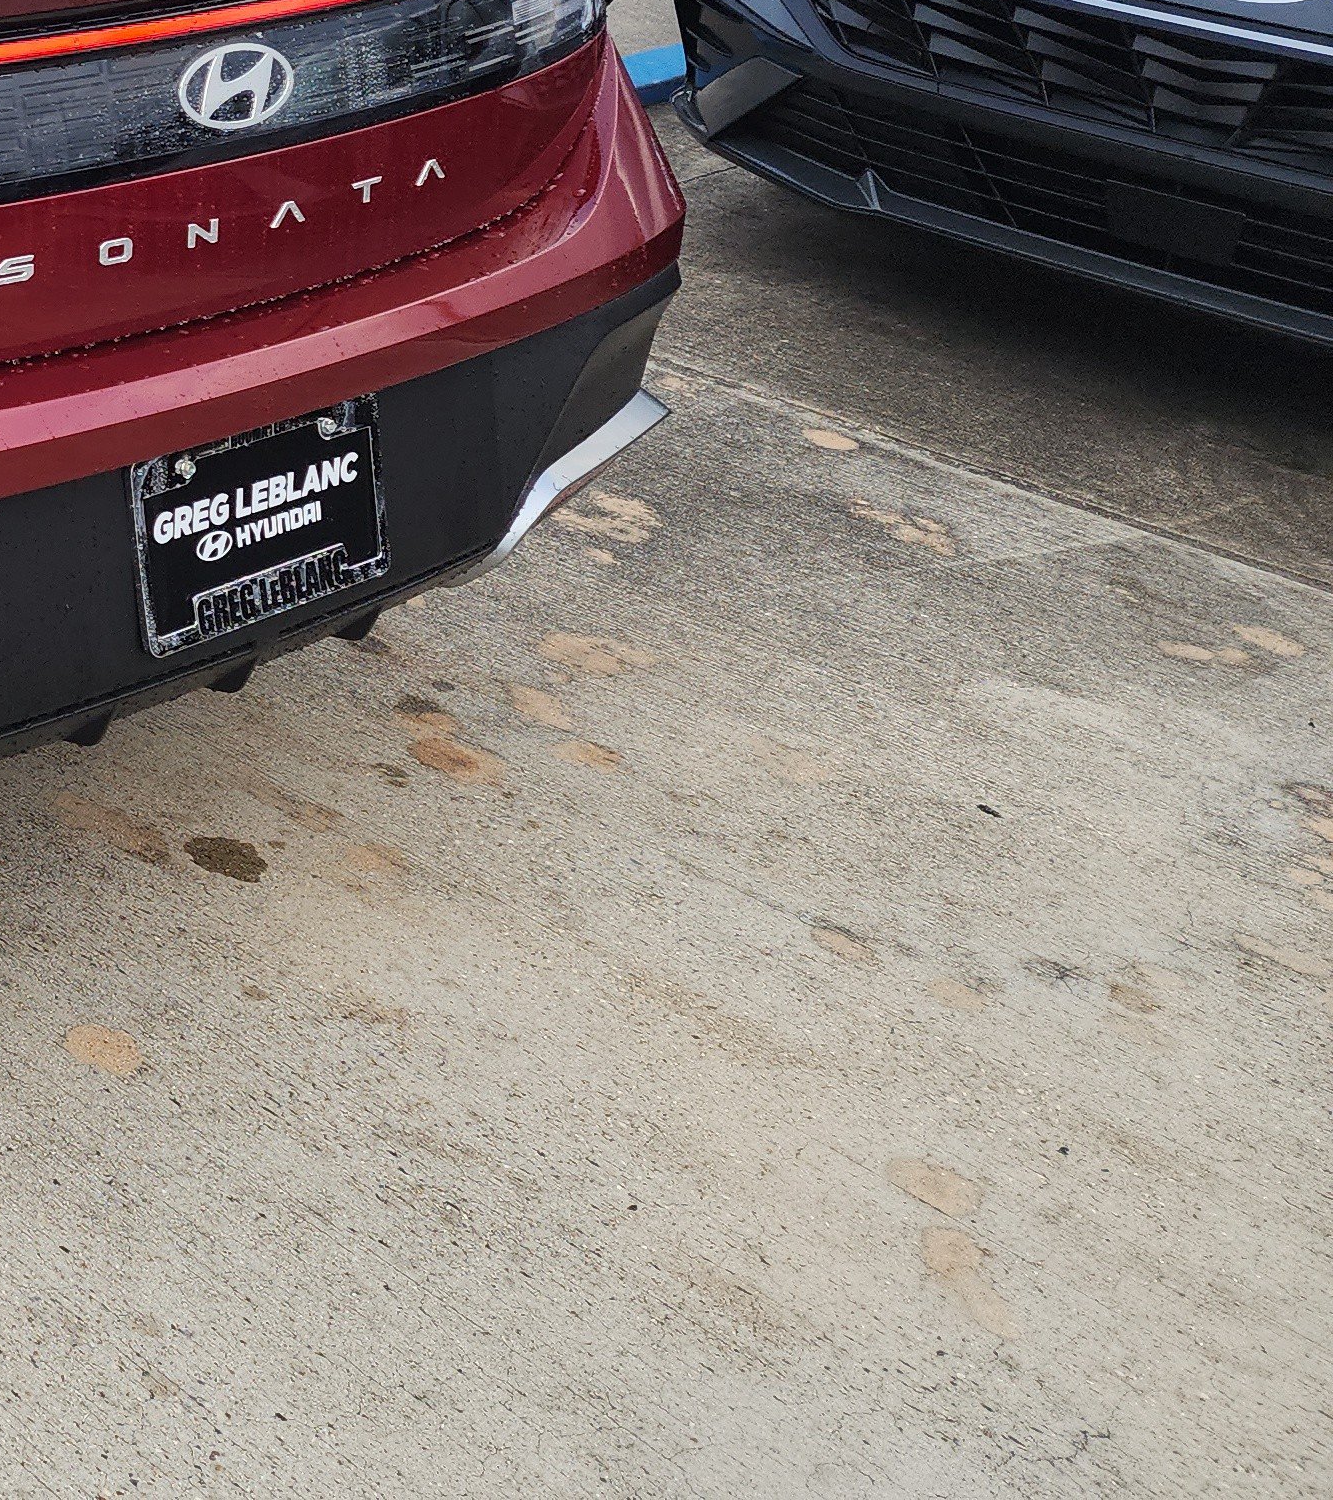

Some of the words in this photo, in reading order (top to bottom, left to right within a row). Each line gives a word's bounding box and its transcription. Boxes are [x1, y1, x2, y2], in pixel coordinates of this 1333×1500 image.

[152, 492, 230, 544] GREG
[235, 451, 359, 519] LEBLANC
[235, 500, 322, 548] HYUNDAI
[197, 579, 257, 637] GREG
